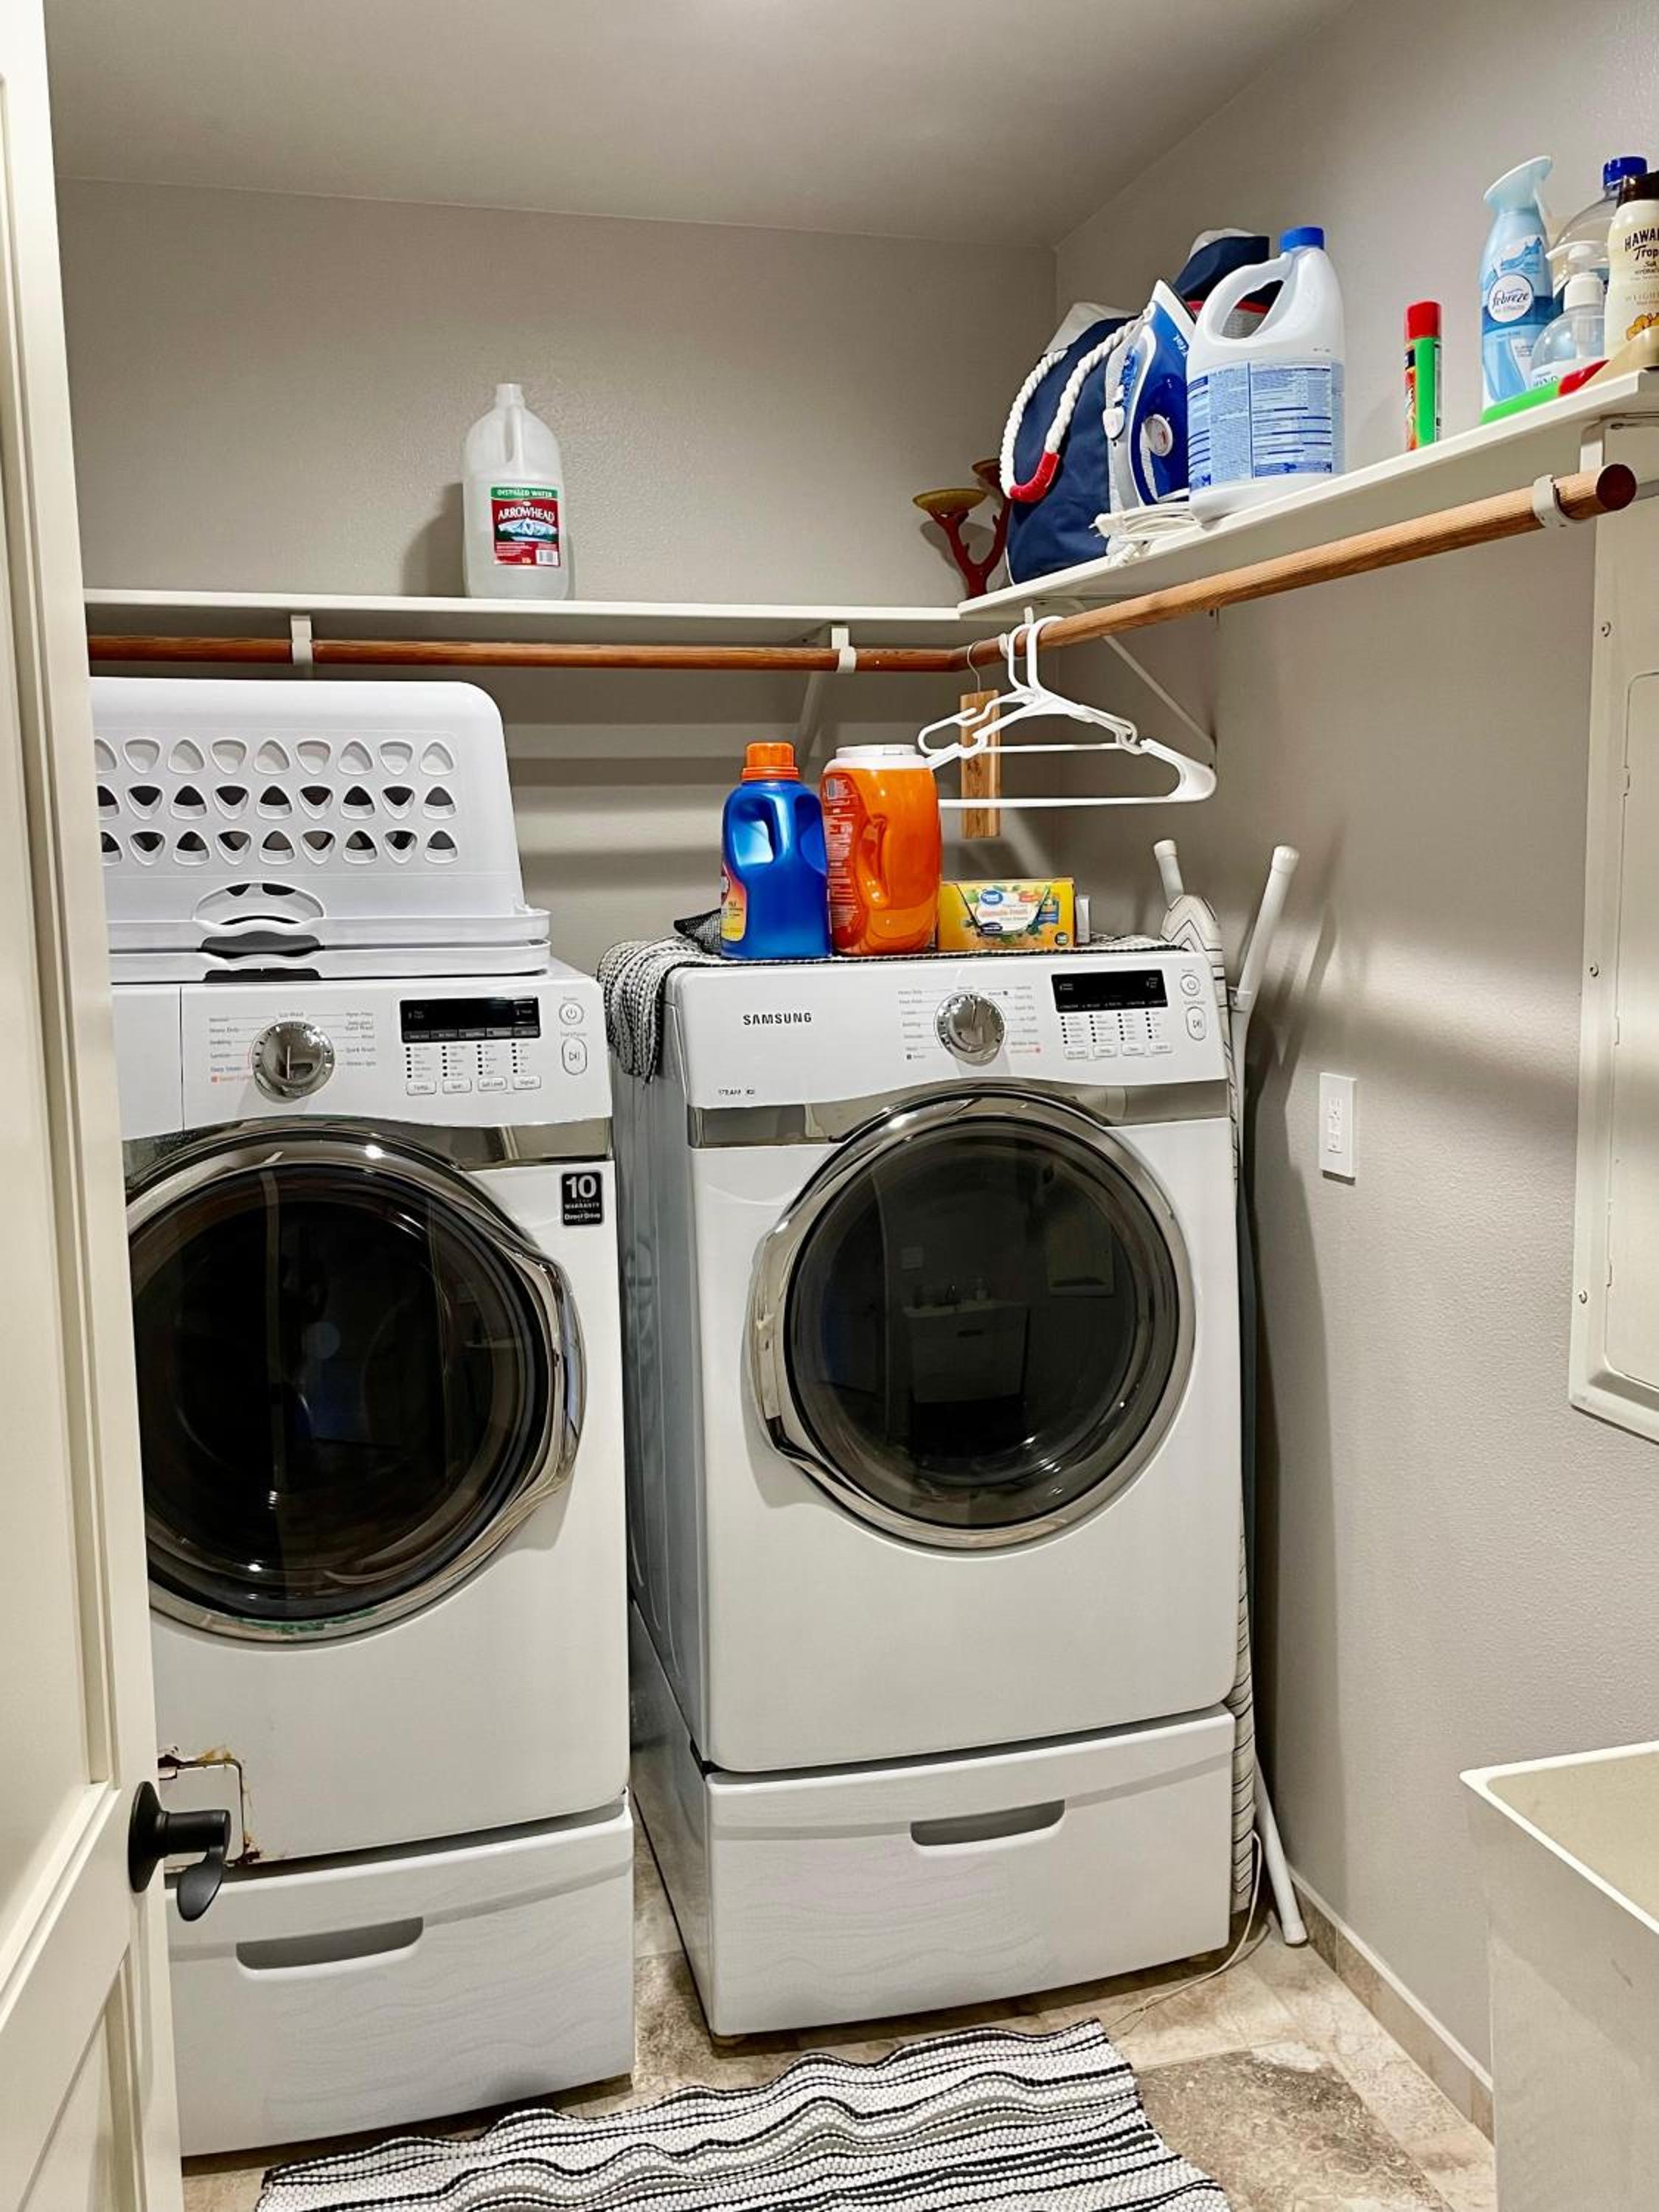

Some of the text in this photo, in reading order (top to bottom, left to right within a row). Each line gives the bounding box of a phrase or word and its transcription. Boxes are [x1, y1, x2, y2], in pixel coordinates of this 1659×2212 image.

[1492, 288, 1529, 309] febreze
[497, 489, 529, 497] DISTILLED
[498, 507, 555, 524] ARROWHEAD
[742, 1012, 812, 1026] SAMSUNG
[566, 1175, 597, 1199] 10
